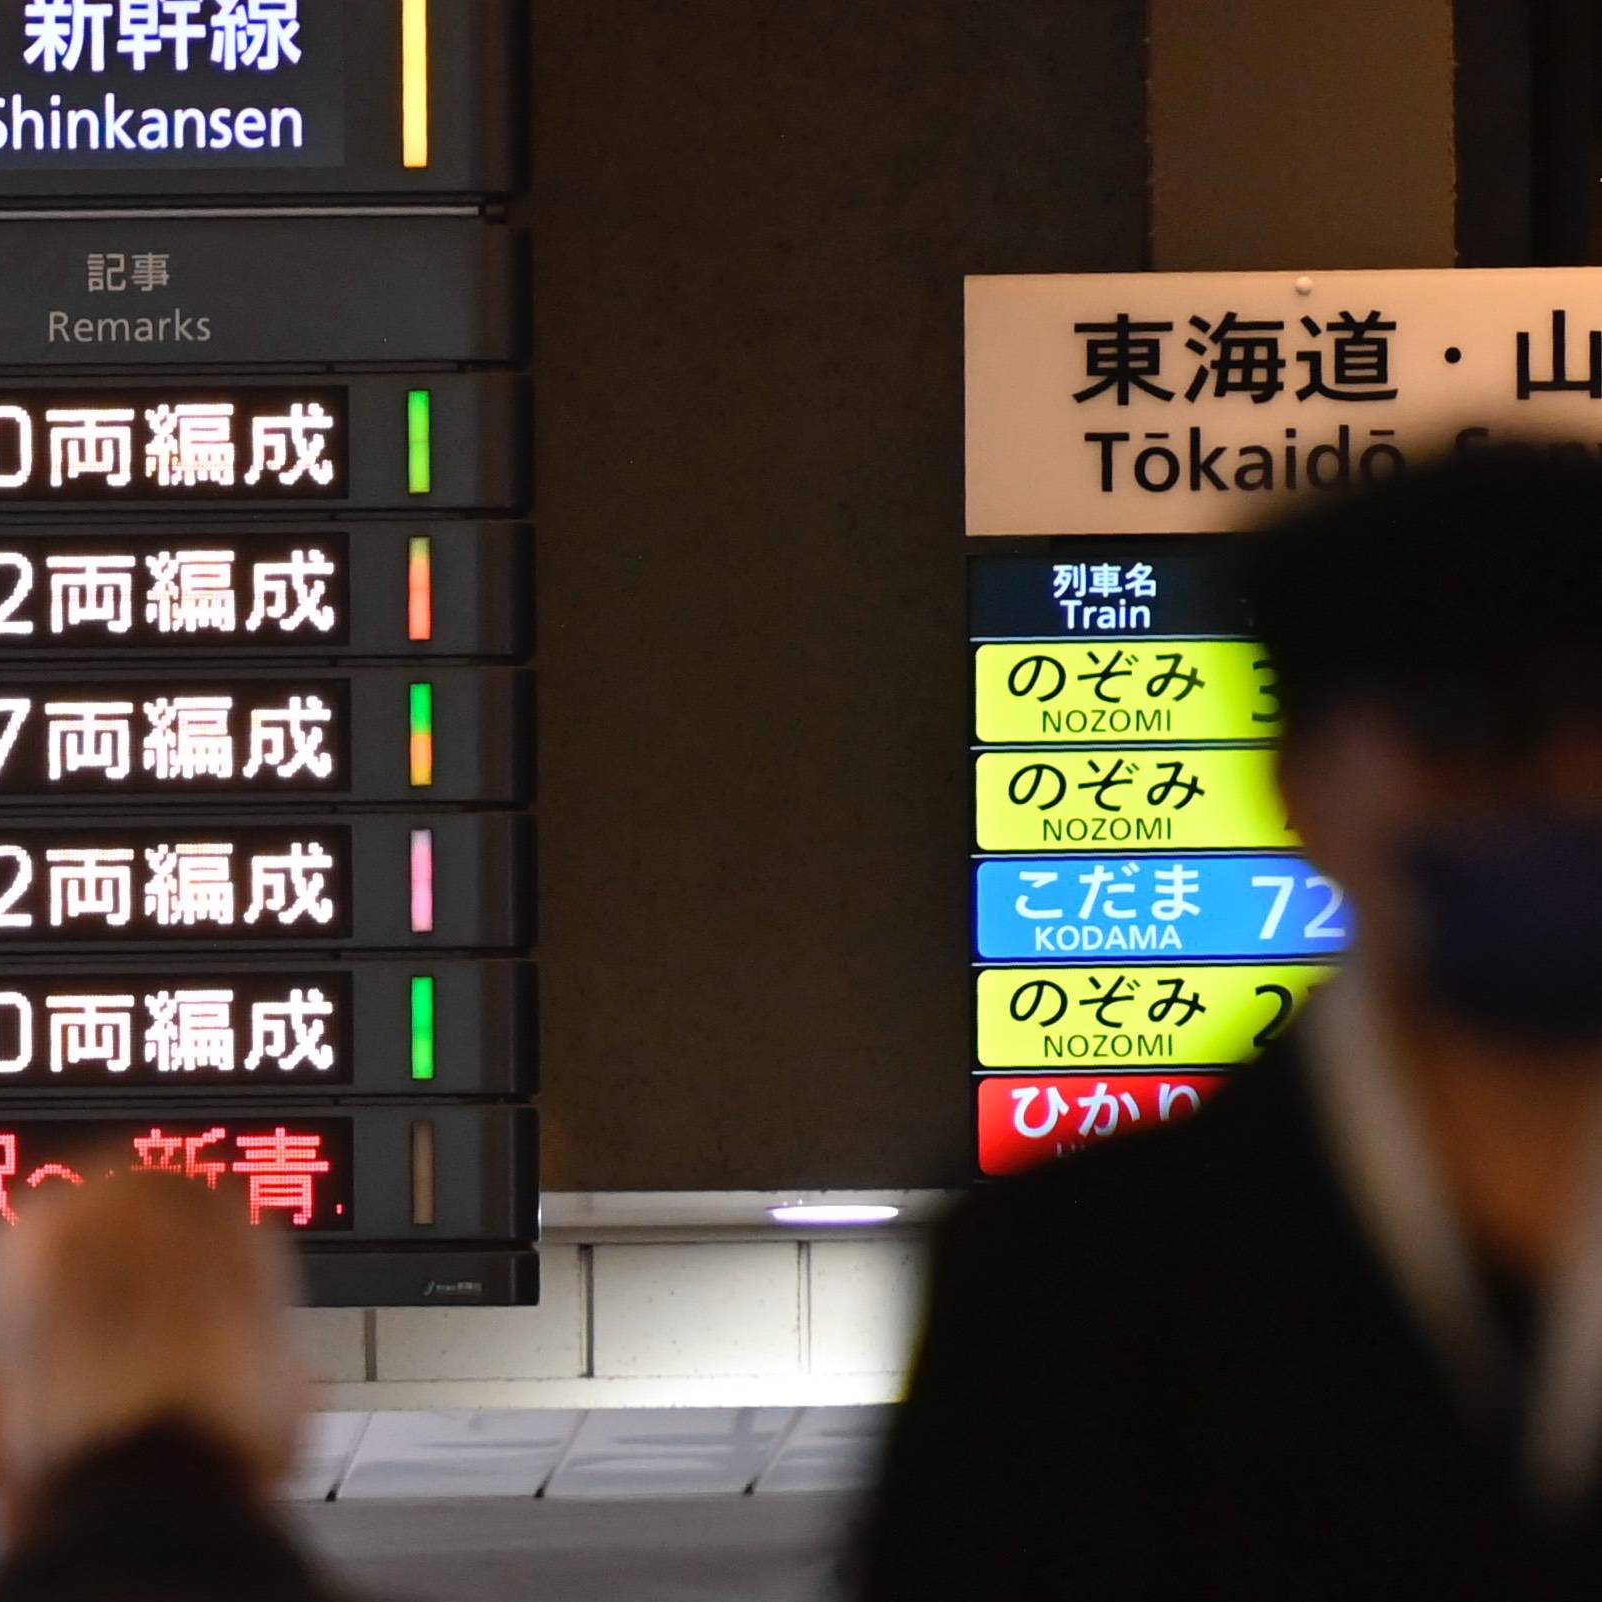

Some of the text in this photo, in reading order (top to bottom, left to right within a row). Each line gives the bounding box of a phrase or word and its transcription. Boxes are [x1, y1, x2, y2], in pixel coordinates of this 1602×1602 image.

[87, 252, 170, 292] 記事
[49, 309, 211, 343] Remarks
[1052, 563, 1157, 599] 列車名
[1060, 599, 1151, 630] Train
[1007, 650, 1206, 703] のぞみ
[1041, 708, 1172, 734] NOZOMI
[1007, 757, 1206, 812] のぞみ
[1042, 816, 1173, 842] NOZOMI
[1014, 862, 1202, 921] こだま
[1034, 924, 1184, 952] KODAMA
[1009, 974, 1207, 1029] のぞみ
[1043, 1033, 1174, 1059] NOZOMI
